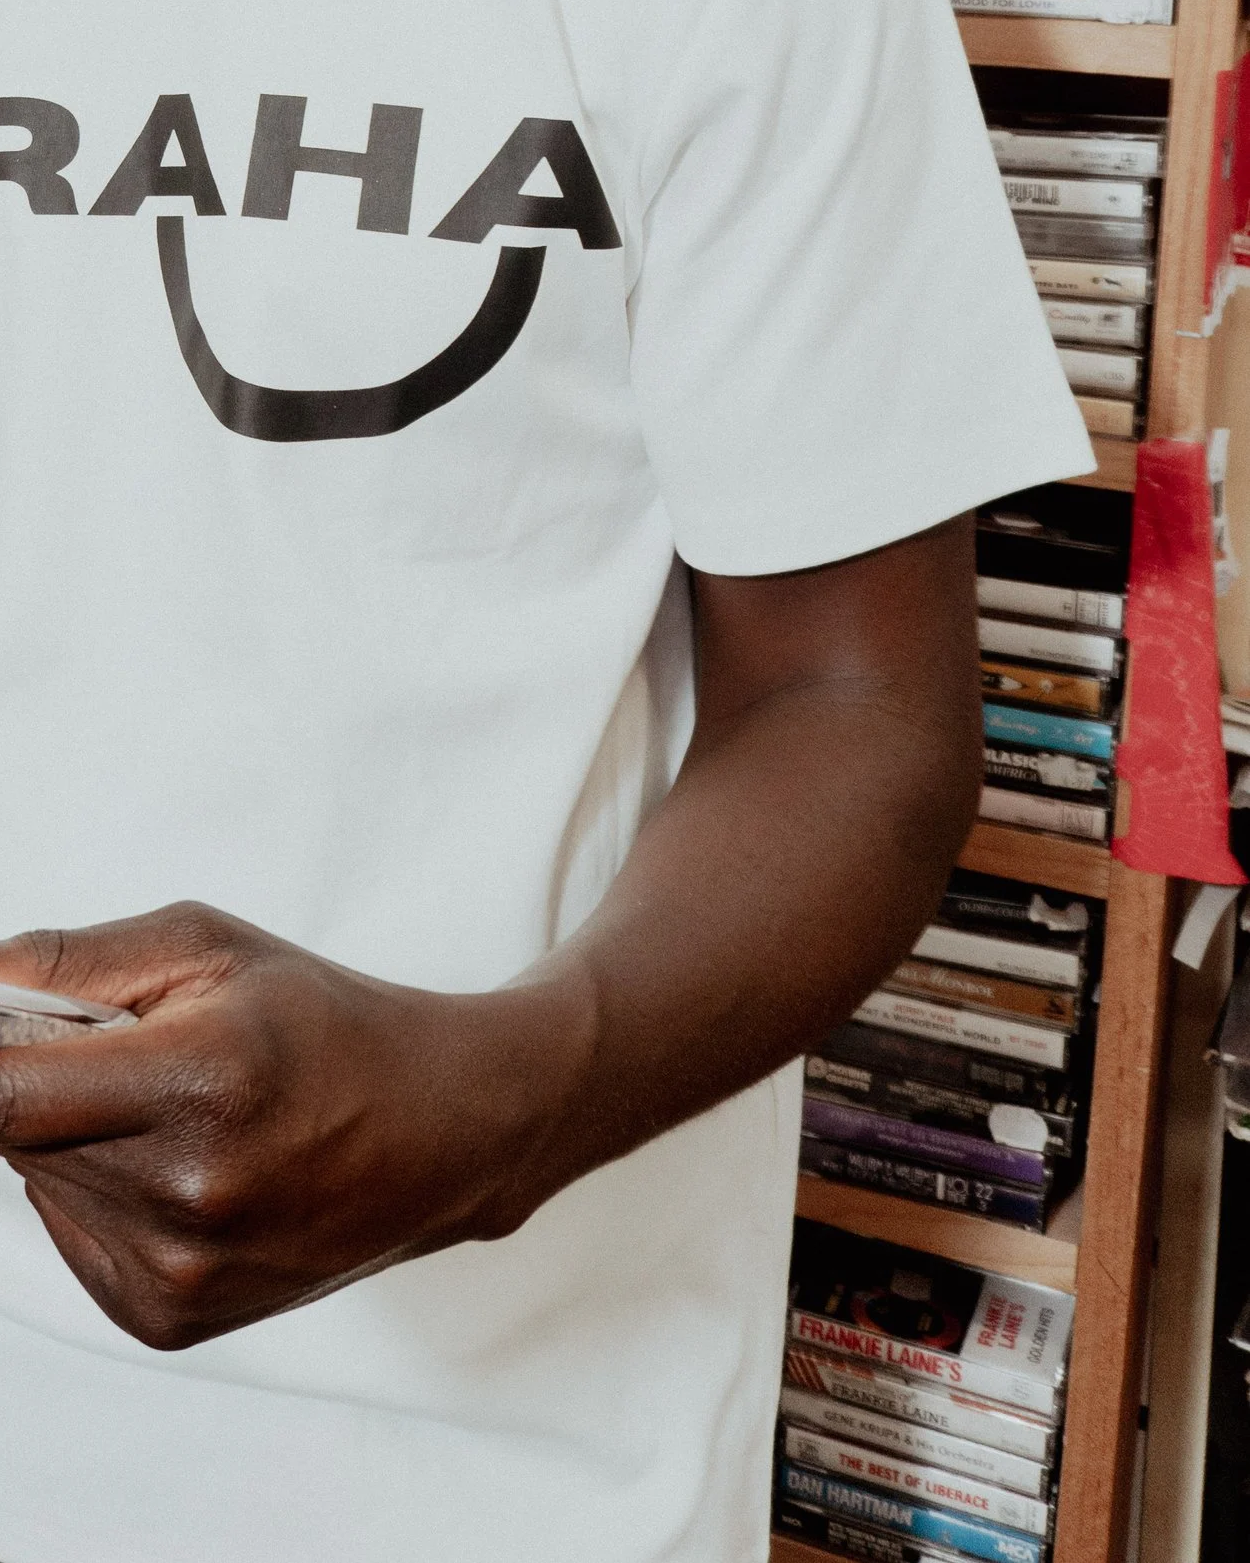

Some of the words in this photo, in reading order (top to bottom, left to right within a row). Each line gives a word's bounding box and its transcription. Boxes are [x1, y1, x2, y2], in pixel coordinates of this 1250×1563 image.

[960, 1028, 1001, 1045] WORLD
[799, 1315, 884, 1359] FRANKIE
[886, 1341, 964, 1383] LAINE'S
[977, 1295, 1007, 1348] FRANKIE
[999, 1299, 1028, 1351] LAINE'S
[1026, 1327, 1047, 1364] GOLDEN
[1040, 1307, 1056, 1329] HITS
[823, 1409, 856, 1427] GENE
[858, 1417, 901, 1441] KRUPA
[903, 1434, 914, 1446] &
[937, 1444, 996, 1472] Orchestra
[901, 1403, 950, 1428] LAINE
[786, 1469, 824, 1499] DAN
[826, 1481, 915, 1527] HARTMAN
[837, 1452, 864, 1471] THE
[868, 1461, 902, 1484] BEST
[904, 1472, 923, 1488] OF
[924, 1479, 990, 1511] LIBERACE
